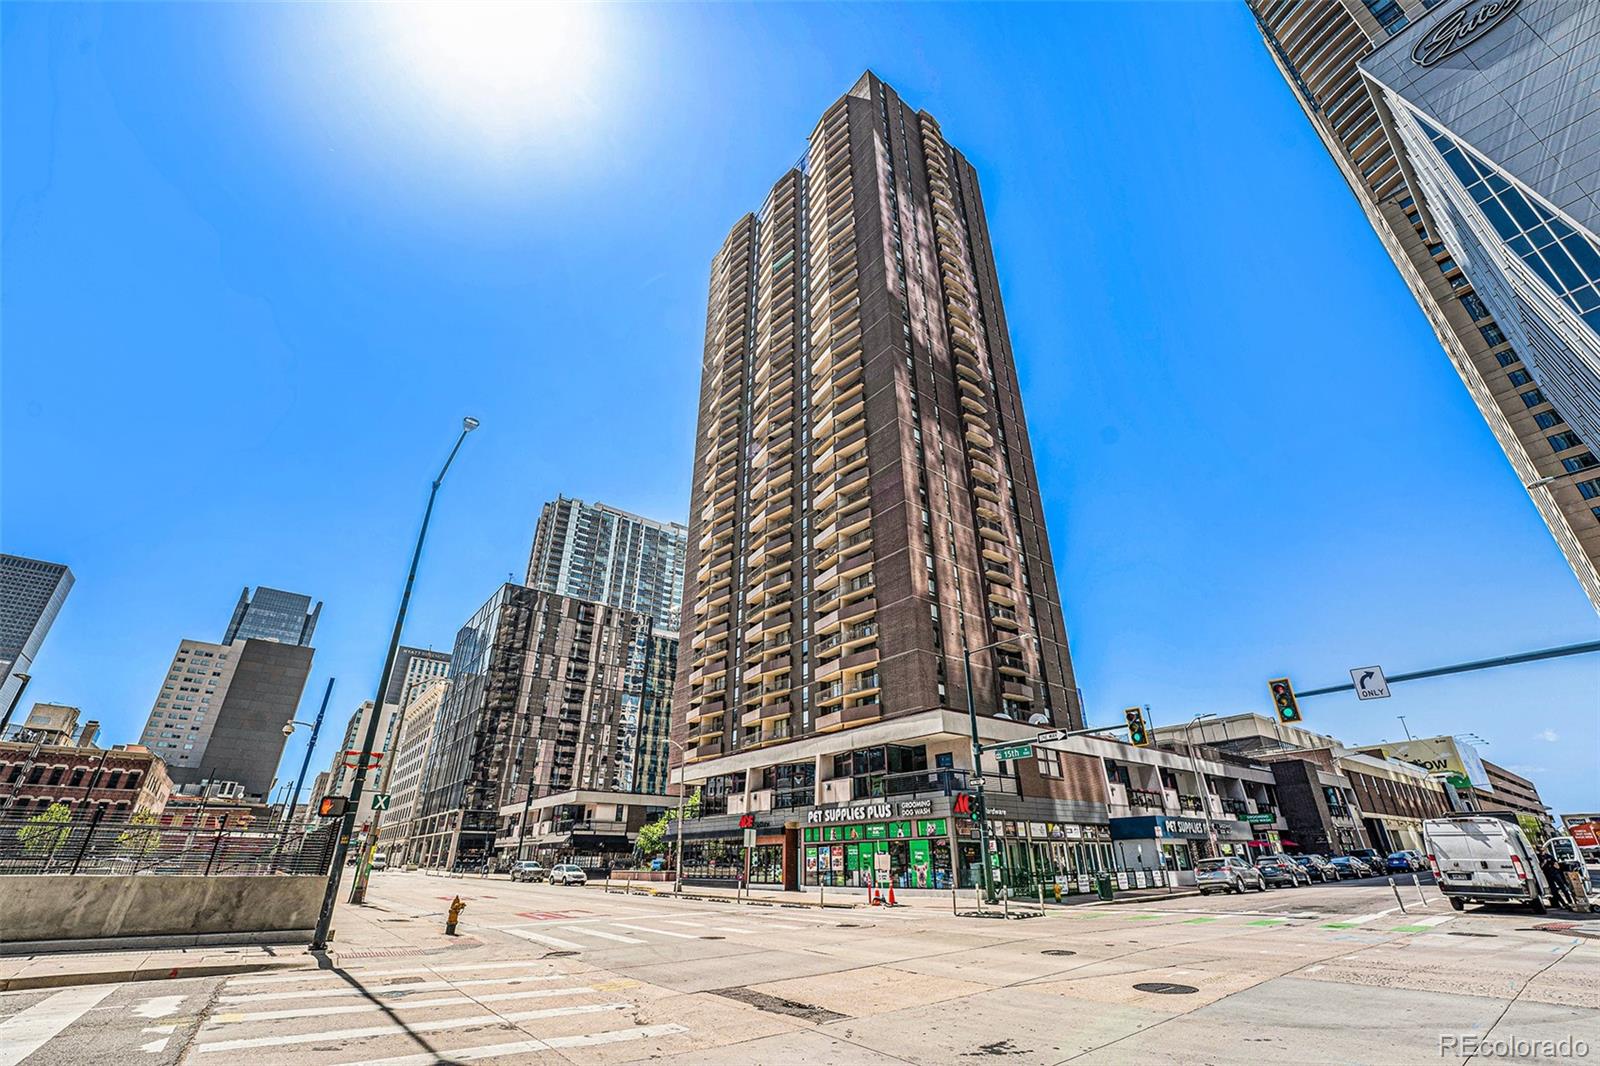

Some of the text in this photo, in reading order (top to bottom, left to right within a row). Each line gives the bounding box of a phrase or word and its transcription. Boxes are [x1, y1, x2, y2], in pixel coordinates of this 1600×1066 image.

[1362, 689, 1384, 697] ONLY
[1004, 750, 1020, 758] 15th
[901, 800, 931, 809] GROOMING
[808, 804, 892, 823] PET SUPPLIES PLUS
[914, 808, 931, 816] WASH
[1165, 820, 1177, 833] PET
[1178, 820, 1203, 834] SUPPLIES
